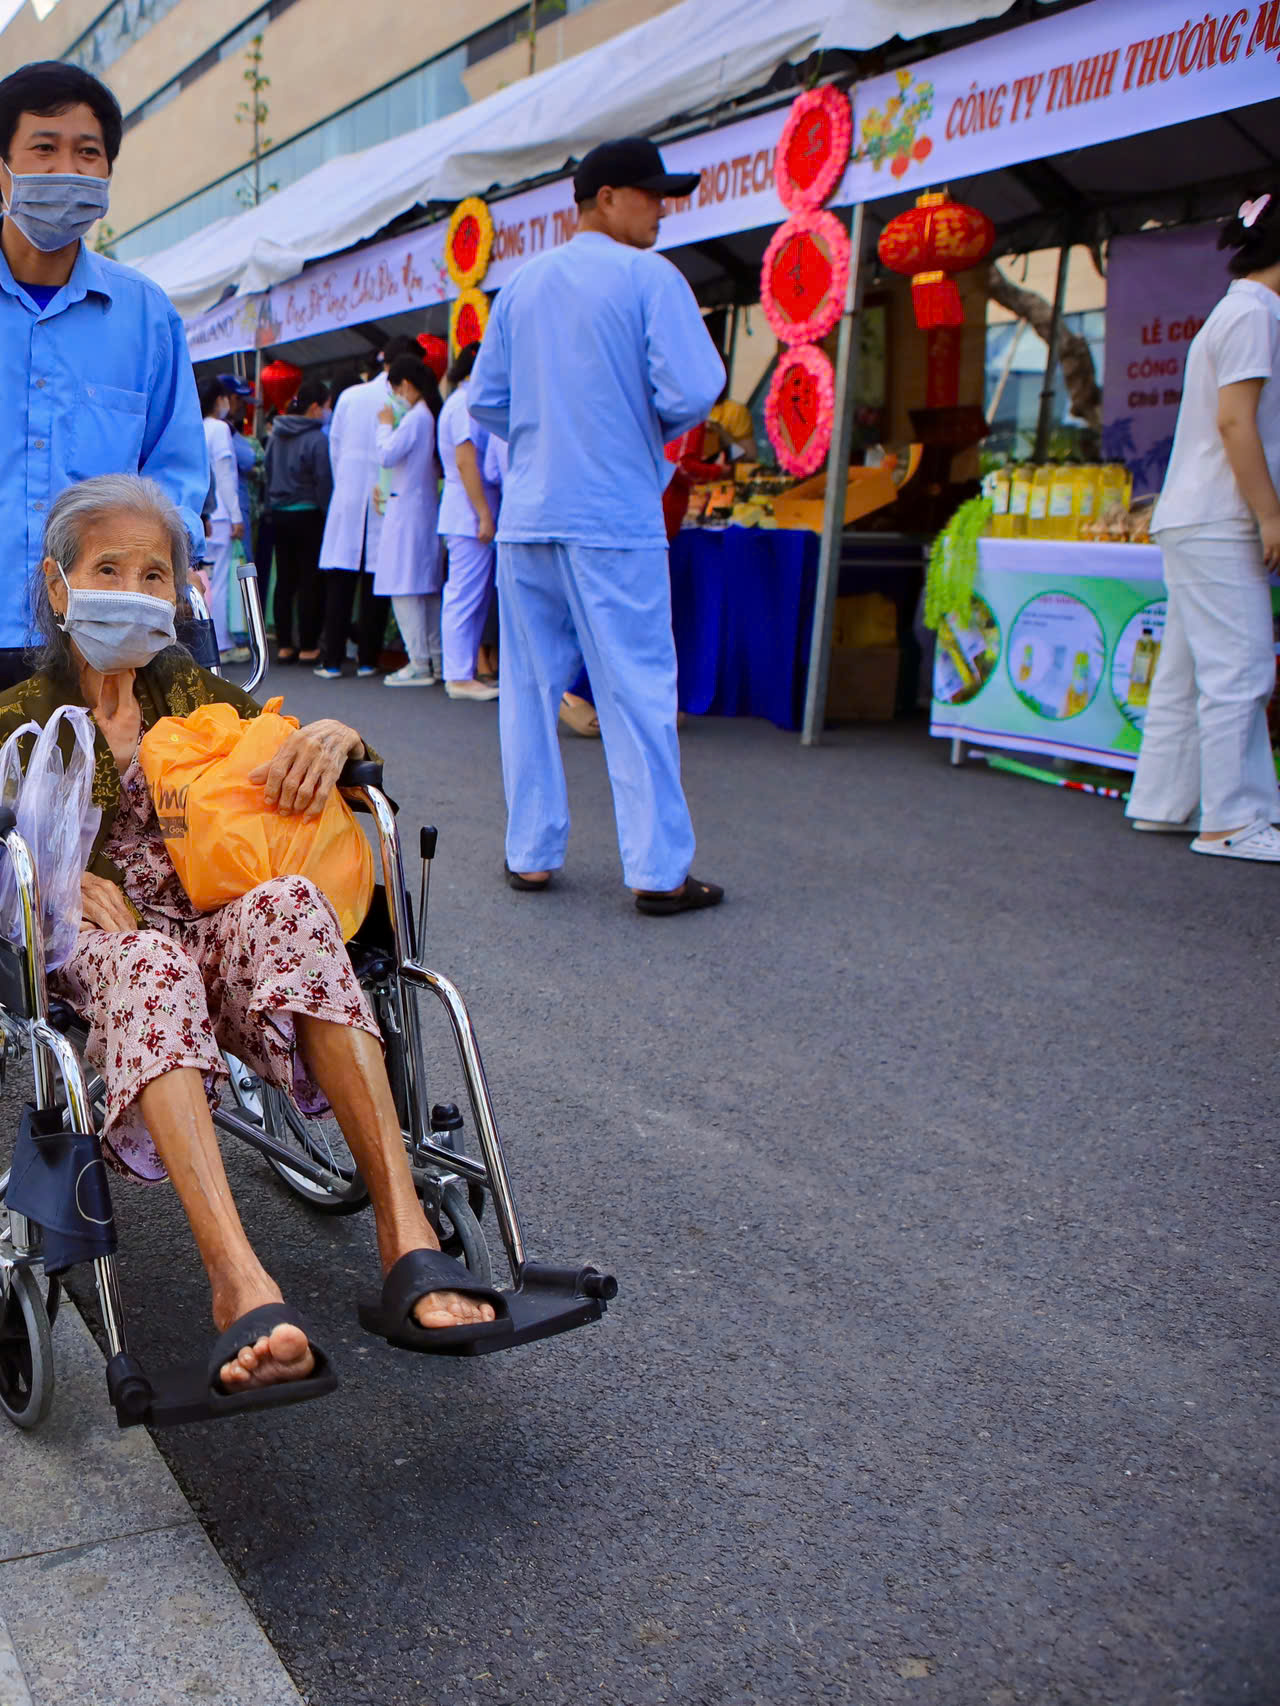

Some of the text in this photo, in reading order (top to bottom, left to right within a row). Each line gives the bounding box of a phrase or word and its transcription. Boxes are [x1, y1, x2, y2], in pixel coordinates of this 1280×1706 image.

[944, 81, 1007, 142] CÔNG
[1009, 71, 1044, 123] TY
[1045, 48, 1121, 114] TNHH
[1122, 13, 1249, 93] THƯƠNG
[530, 214, 548, 249] TY
